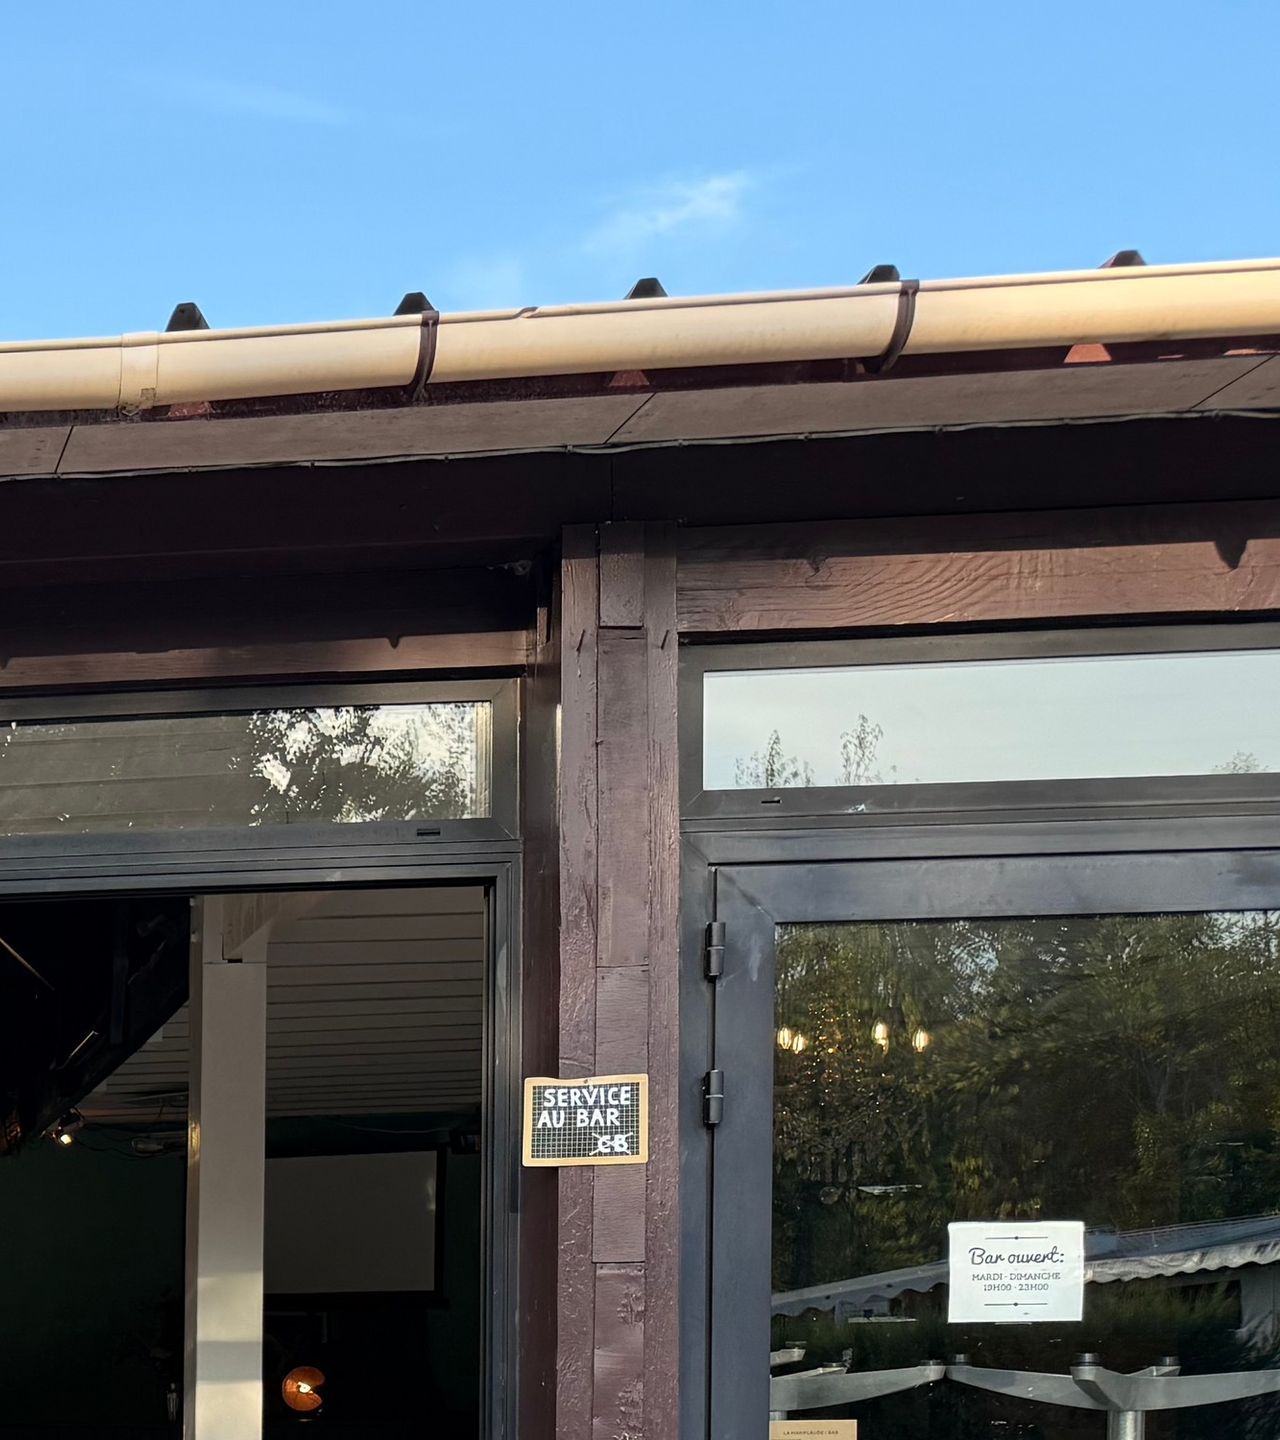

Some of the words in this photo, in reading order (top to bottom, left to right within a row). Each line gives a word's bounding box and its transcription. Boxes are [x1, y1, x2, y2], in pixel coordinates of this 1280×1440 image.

[543, 1086, 631, 1107] SERVICE
[537, 1110, 565, 1128] AU
[576, 1108, 620, 1127] BAR
[968, 1247, 1005, 1265] Bar
[1007, 1246, 1065, 1264] ouvert:
[972, 1272, 1004, 1281] MARDI
[1009, 1272, 1061, 1281] DIMANCHE
